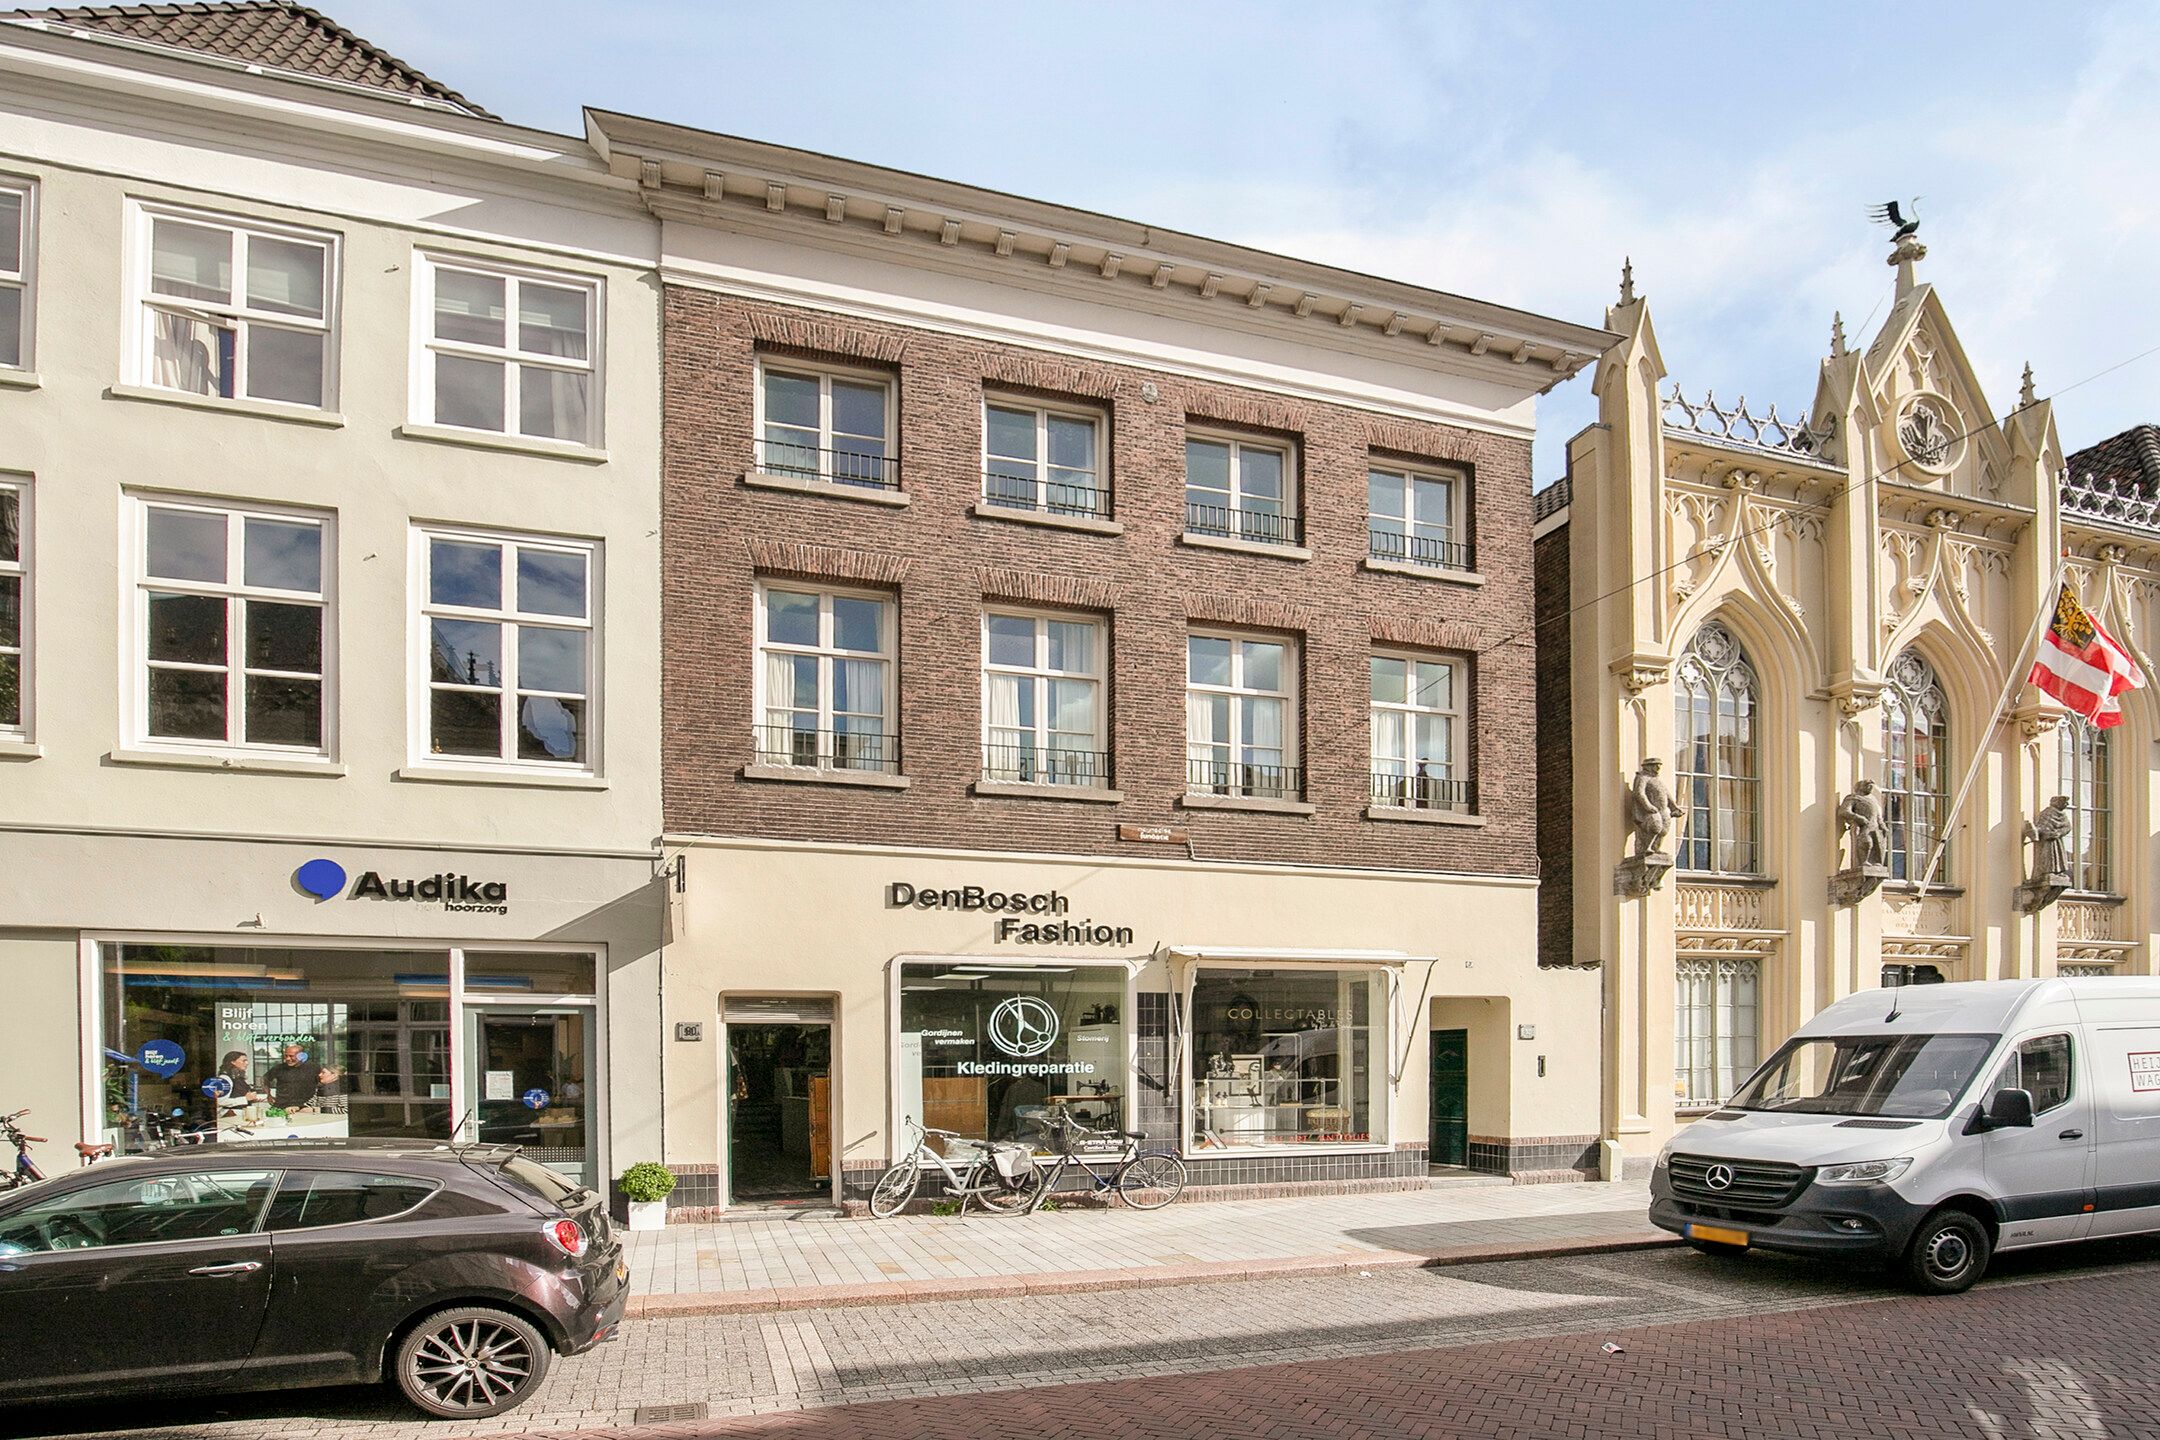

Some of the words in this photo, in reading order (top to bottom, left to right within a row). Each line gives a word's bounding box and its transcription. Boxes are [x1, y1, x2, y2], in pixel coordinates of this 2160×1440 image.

[355, 872, 507, 901] Audika
[892, 882, 1069, 914] DenBosch
[444, 902, 508, 916] hoorzorg
[1001, 917, 1134, 944] Fashion
[222, 1008, 253, 1020] Blijf
[1228, 1008, 1354, 1020] COLLECTABLES
[222, 1020, 267, 1030] horen
[223, 1032, 231, 1042] &
[261, 1033, 316, 1042] verbonden
[921, 1029, 964, 1039] Gordijnen
[1076, 1034, 1110, 1044] Stomerij
[934, 1038, 976, 1046] vermaken
[957, 1061, 1095, 1077] Kledingreparatie
